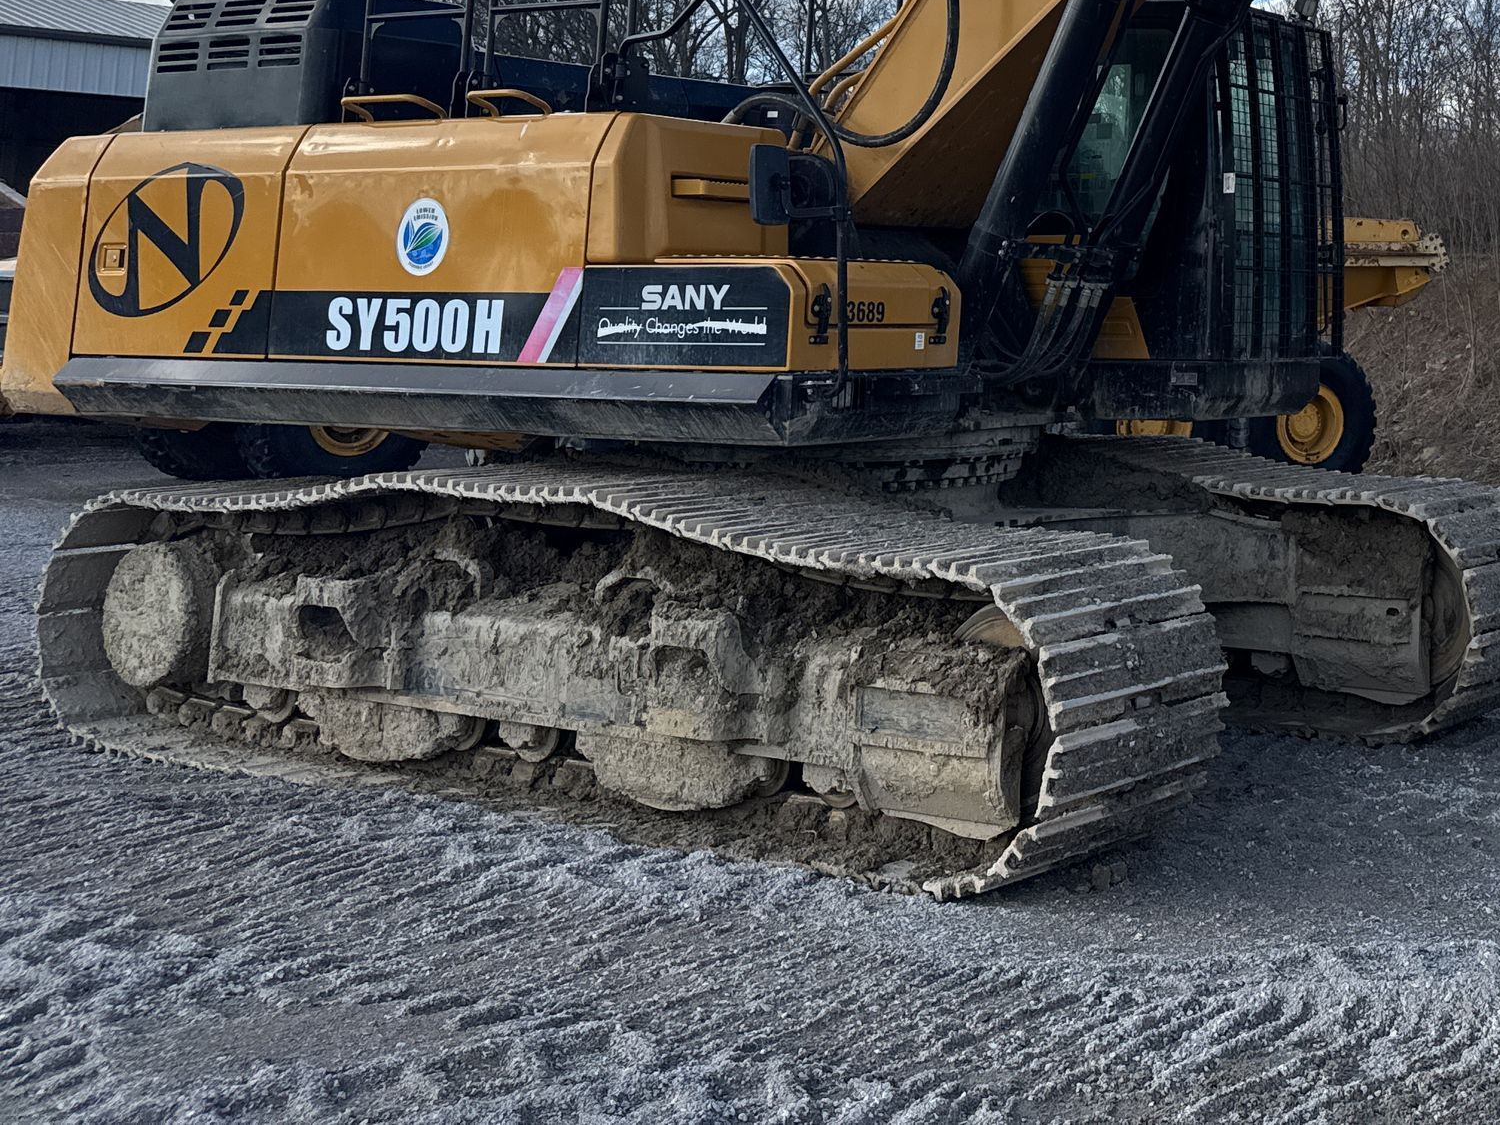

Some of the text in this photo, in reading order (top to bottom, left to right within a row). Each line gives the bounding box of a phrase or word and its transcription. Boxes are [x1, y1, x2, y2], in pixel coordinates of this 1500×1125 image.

[641, 284, 730, 310] SANY
[847, 301, 885, 322] 3689
[326, 297, 504, 354] SY500H
[646, 317, 699, 338] Changes
[726, 316, 767, 334] Wld
